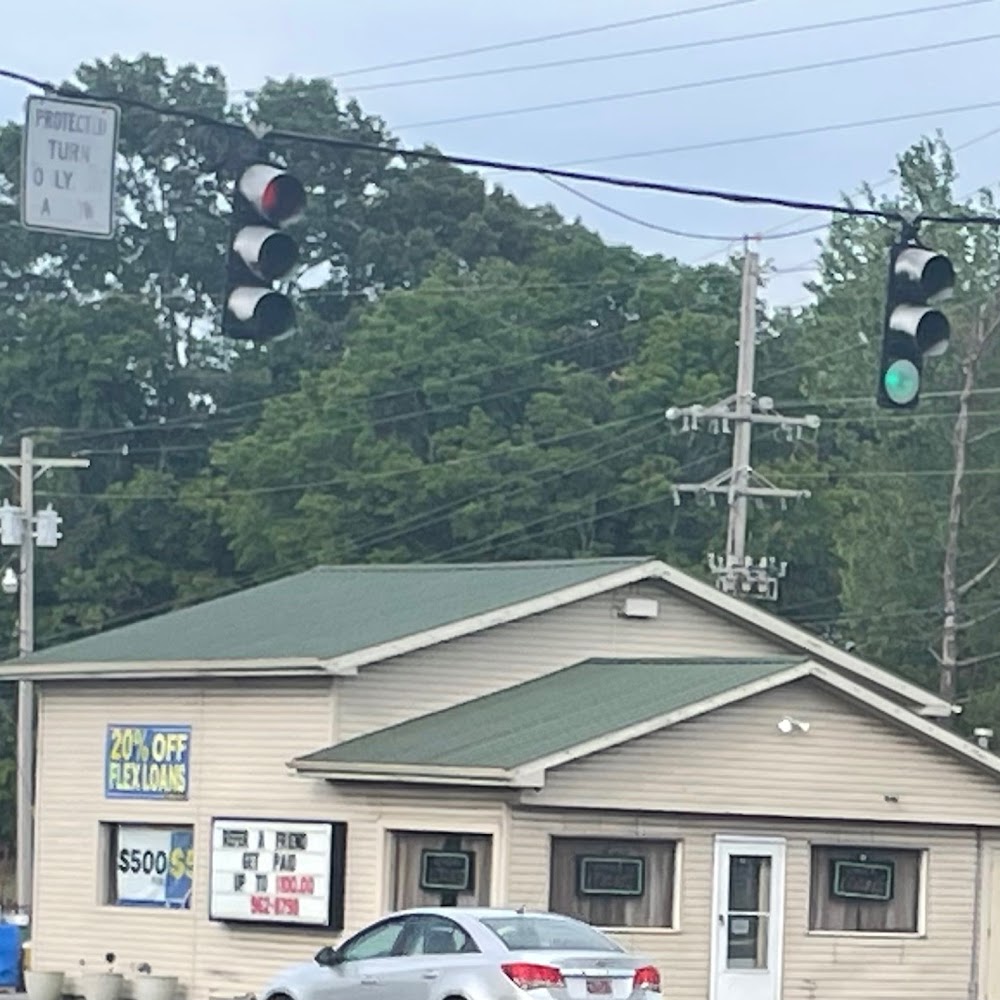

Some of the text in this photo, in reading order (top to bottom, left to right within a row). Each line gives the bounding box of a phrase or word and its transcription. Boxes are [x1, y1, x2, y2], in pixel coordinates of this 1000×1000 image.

[48, 139, 92, 163] TURN
[33, 167, 74, 190] OLY
[111, 728, 188, 762] 20% OFF
[108, 762, 187, 794] FLEX LOANS
[276, 831, 309, 851] FRIEND
[118, 848, 167, 875] $500
[242, 852, 297, 872] GET PAID
[255, 874, 269, 892] TO
